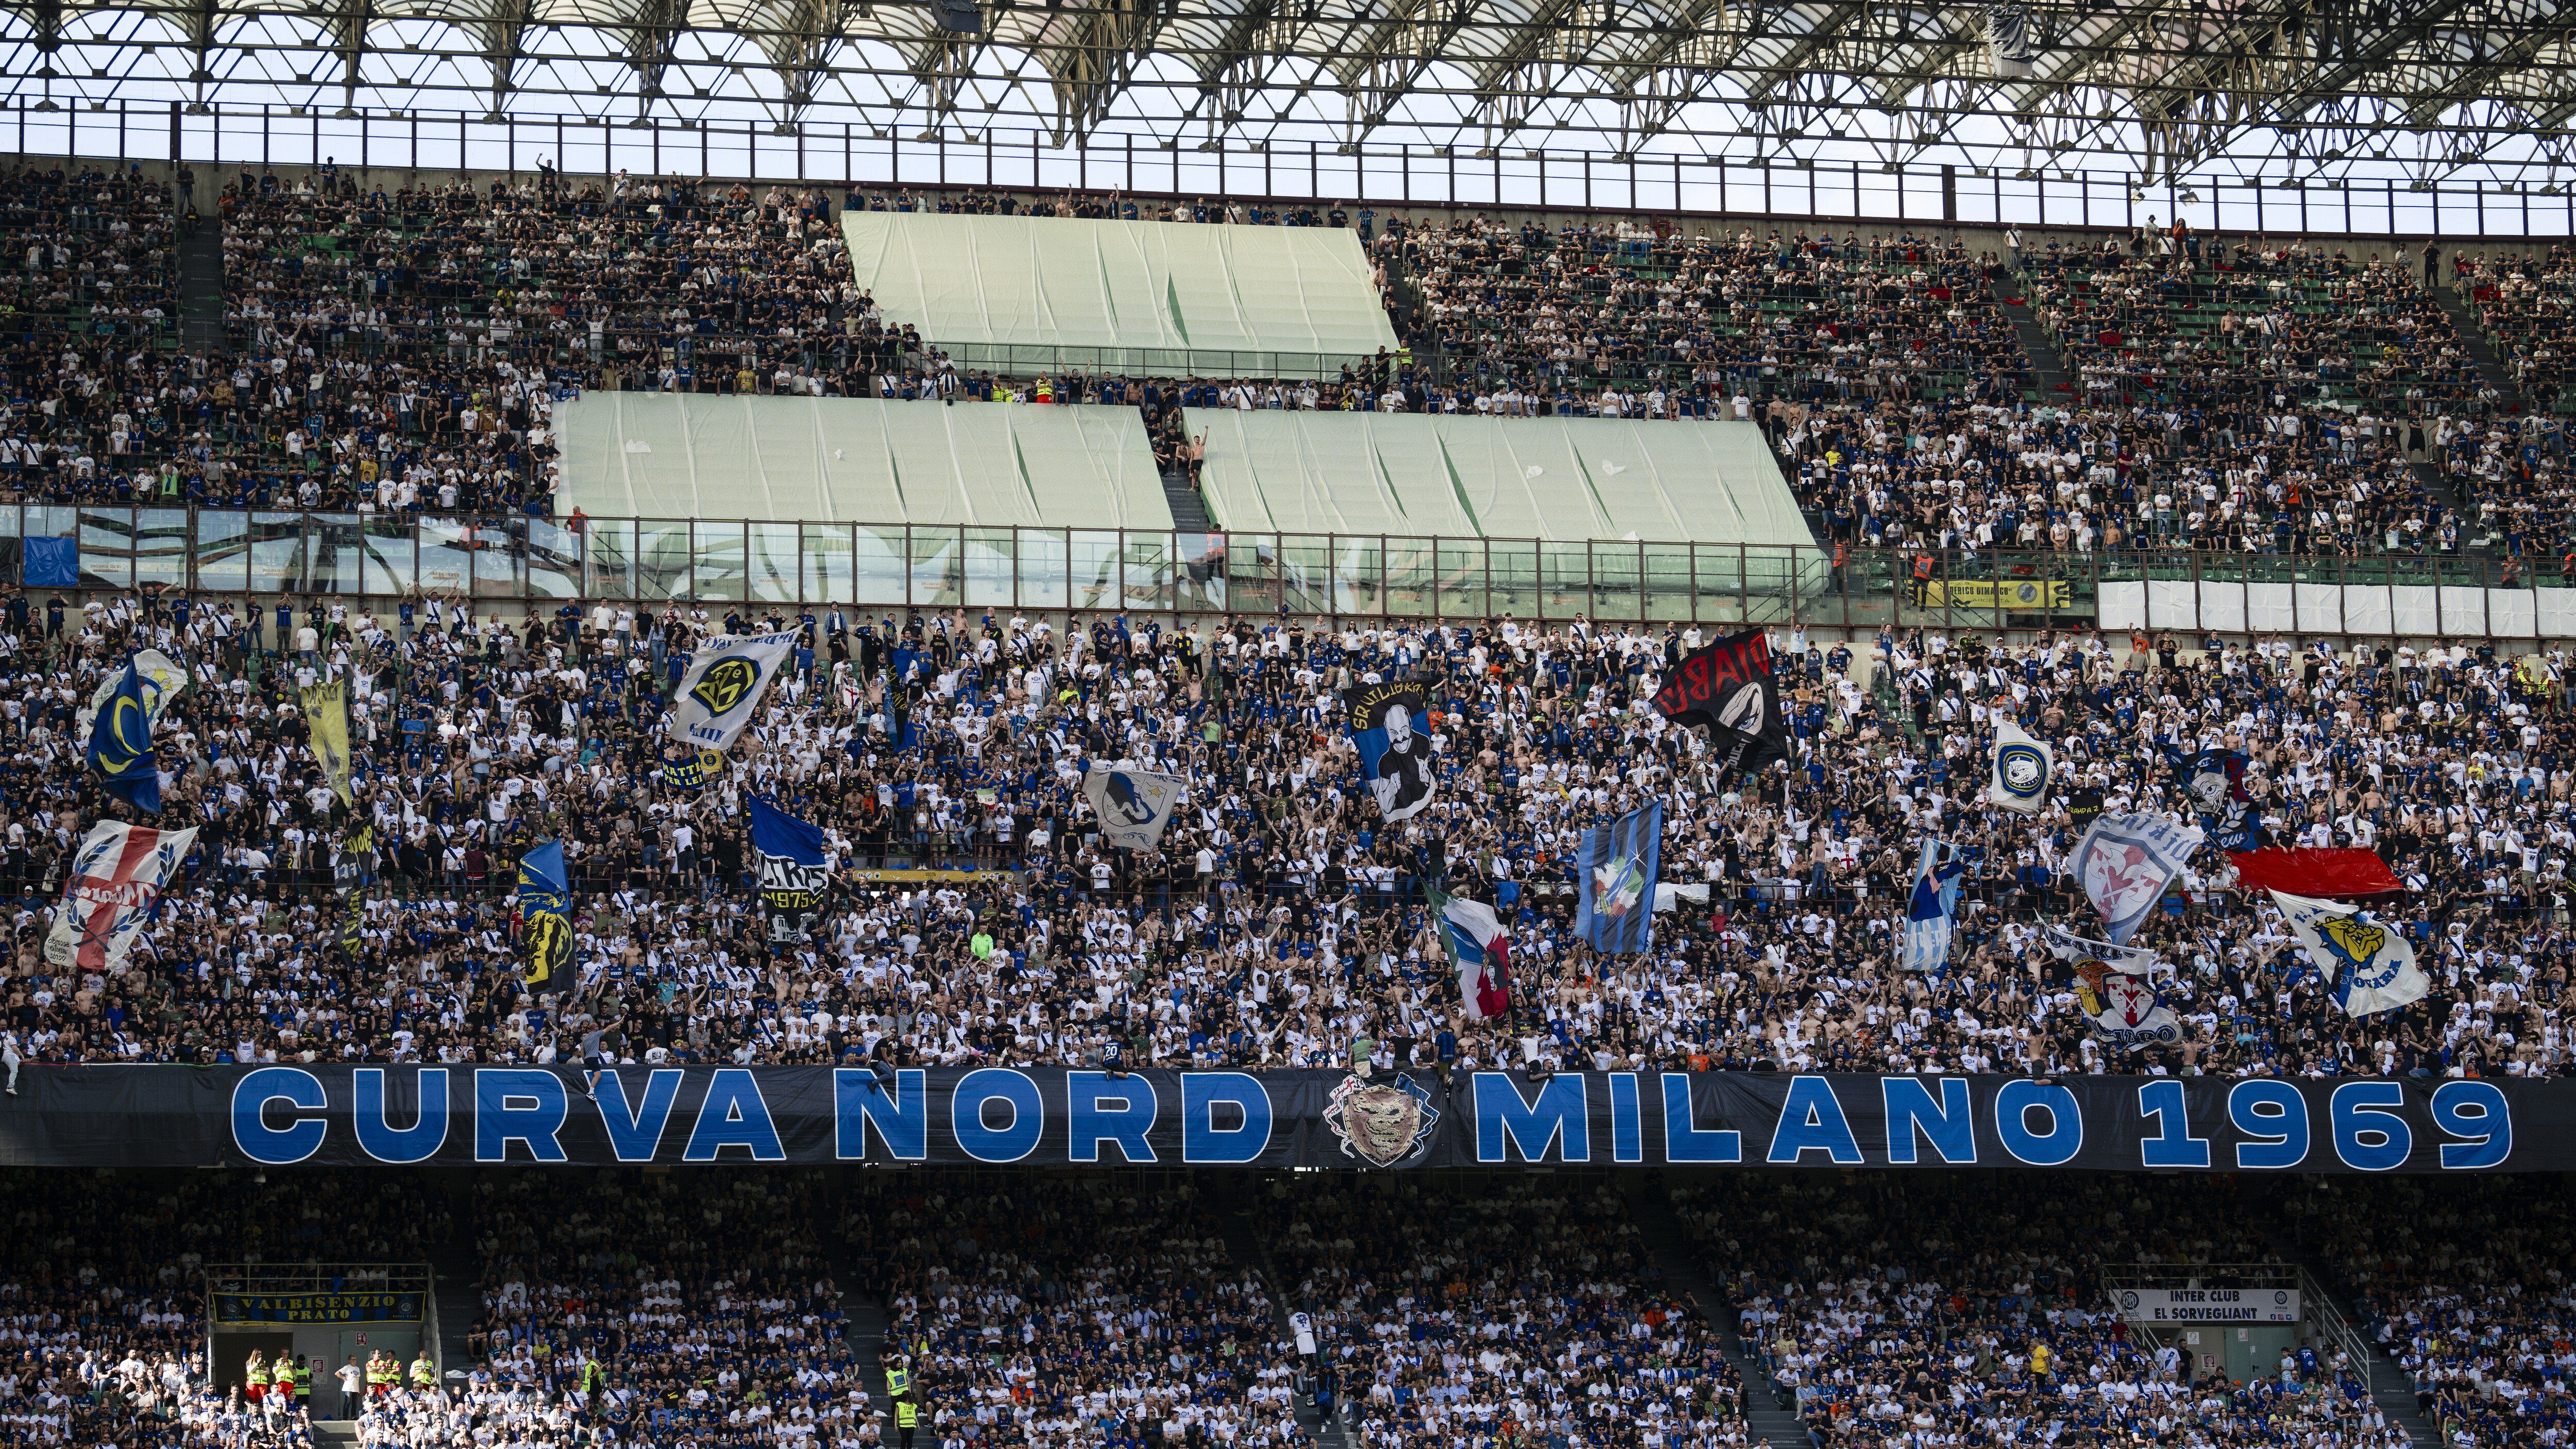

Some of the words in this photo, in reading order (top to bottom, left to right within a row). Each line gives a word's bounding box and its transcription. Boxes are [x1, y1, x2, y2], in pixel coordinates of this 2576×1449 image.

[1939, 586, 1974, 595] "DERICO
[1976, 586, 2012, 595] DIMACO"
[663, 762, 702, 777] MATTI
[665, 774, 682, 786] PER
[686, 774, 703, 786] LEI
[773, 892, 809, 908] 1975
[2340, 959, 2403, 989] NOVARA
[2087, 1018, 2176, 1048] IARO
[1105, 1046, 1117, 1056] 20
[231, 1067, 787, 1165] CURVA
[833, 1068, 1273, 1163] NORD
[1471, 1072, 2083, 1166] MILANO
[2138, 1079, 2513, 1171] 1969
[241, 1295, 395, 1310] VALBISENZIO
[2170, 1290, 2205, 1302] INTER
[2210, 1290, 2240, 1302] CLUB
[288, 1309, 350, 1321] PRATO
[2154, 1308, 2168, 1320] EL
[2172, 1308, 2258, 1320] SORVEGLIANT
